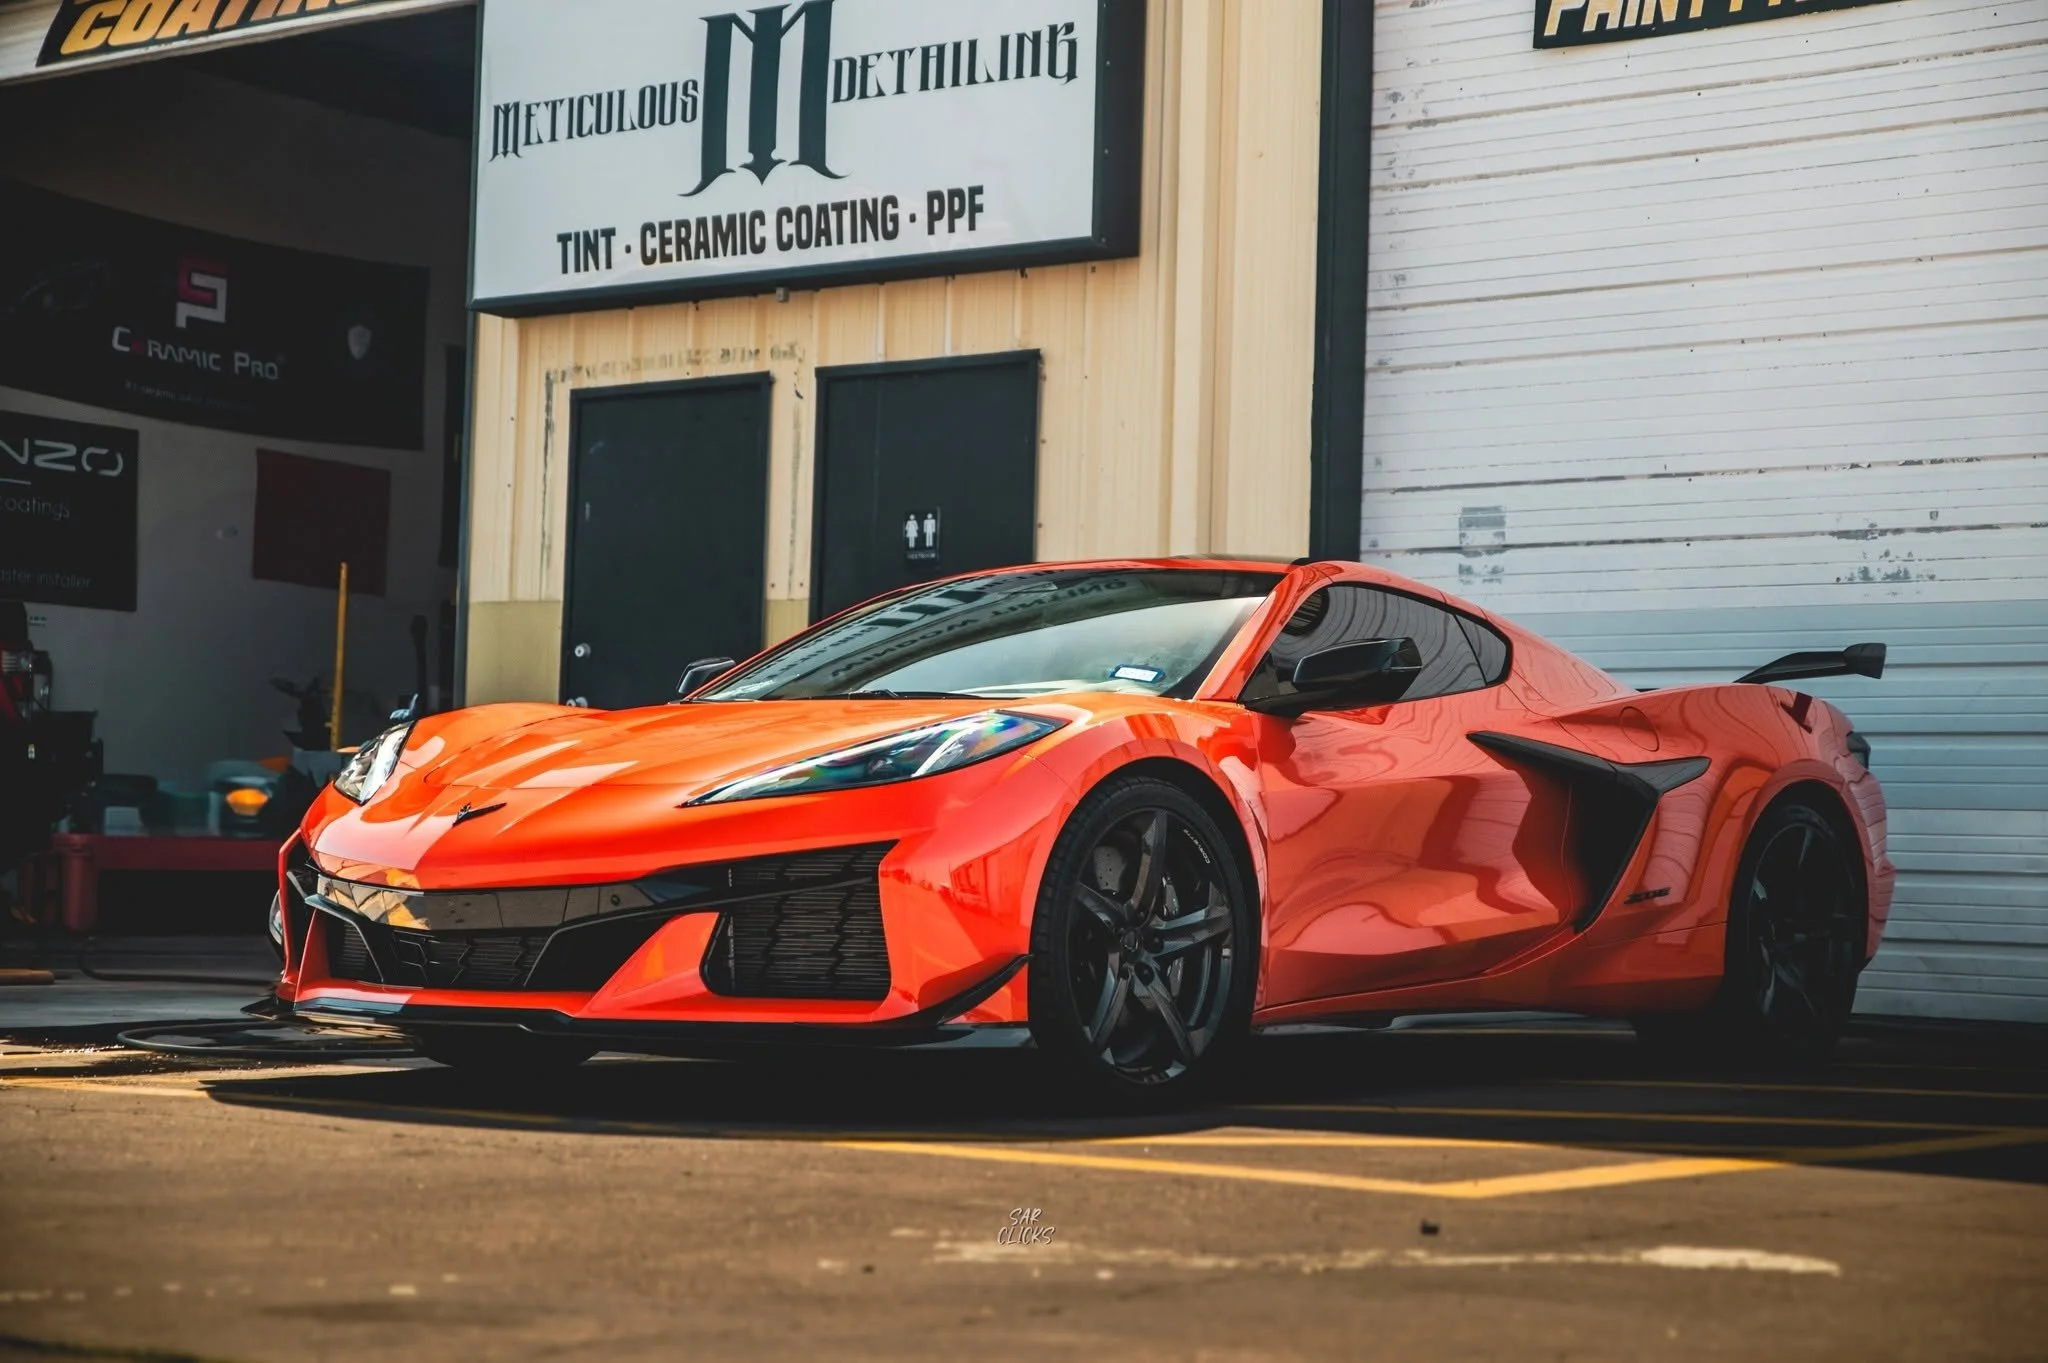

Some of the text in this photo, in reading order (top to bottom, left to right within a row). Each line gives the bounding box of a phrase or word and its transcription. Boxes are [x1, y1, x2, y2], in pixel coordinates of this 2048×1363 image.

[489, 21, 1079, 162] METICULOUS DETAILING
[557, 184, 984, 274] TINT CERAMIC COATING PPF
[0, 496, 70, 521] oatings
